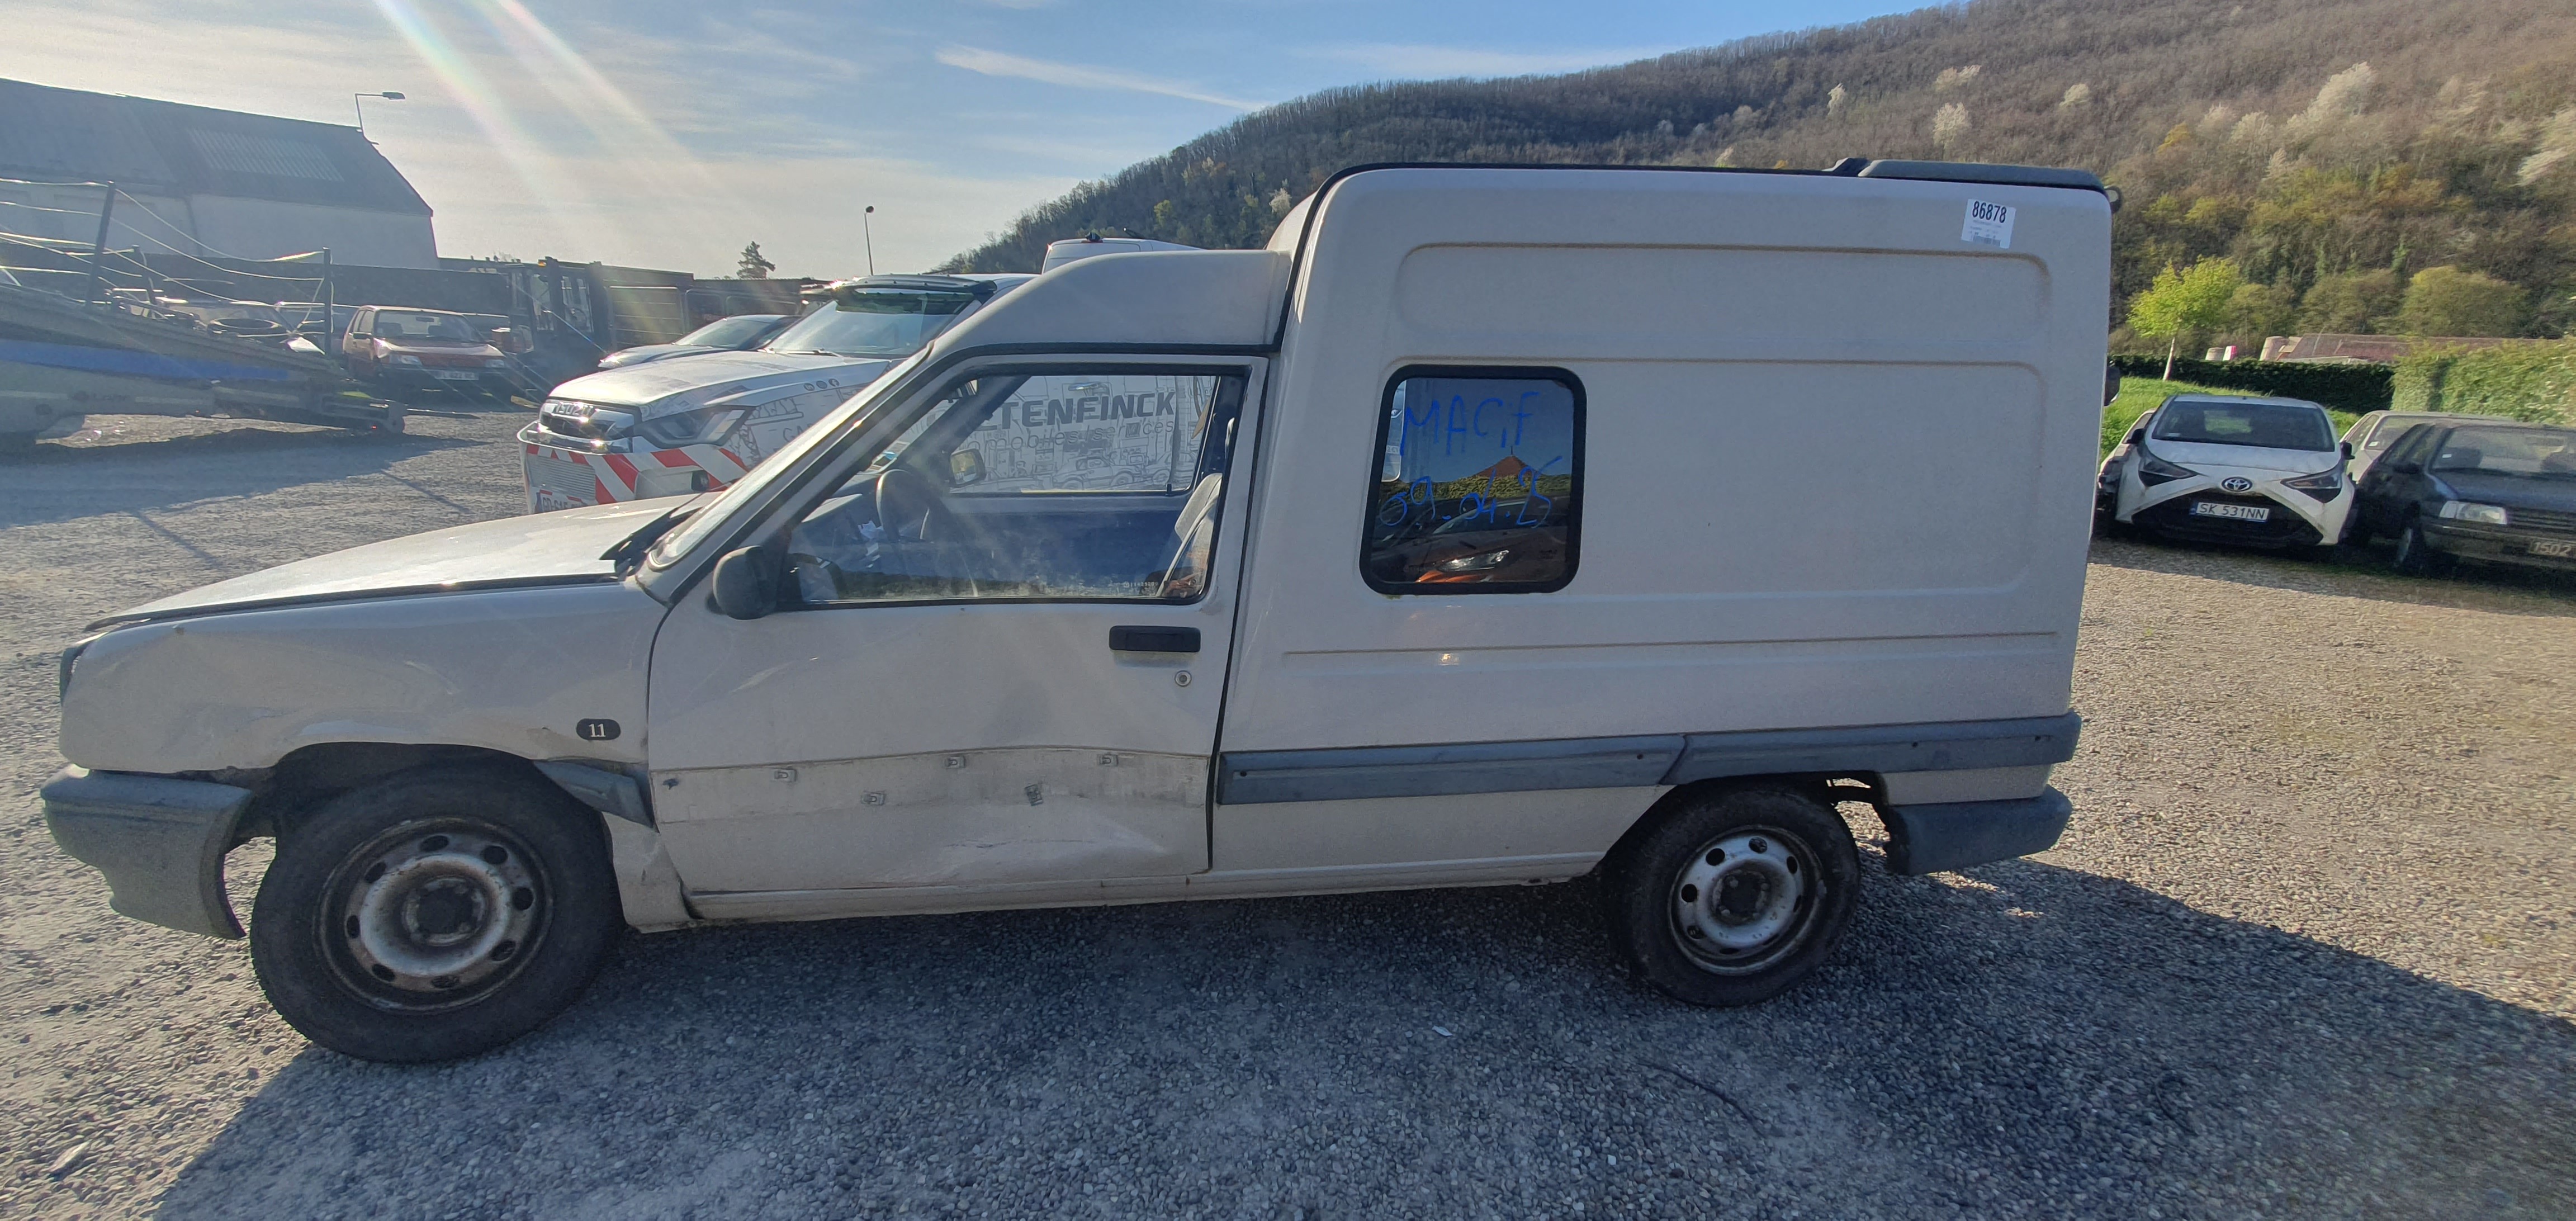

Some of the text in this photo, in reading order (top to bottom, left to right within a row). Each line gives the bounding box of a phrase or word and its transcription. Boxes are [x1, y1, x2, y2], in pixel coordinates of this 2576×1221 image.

[1972, 201, 2007, 224] 86878
[976, 391, 1177, 432] TENFINCK
[2200, 504, 2217, 514] SK
[2221, 505, 2266, 520] 531NN
